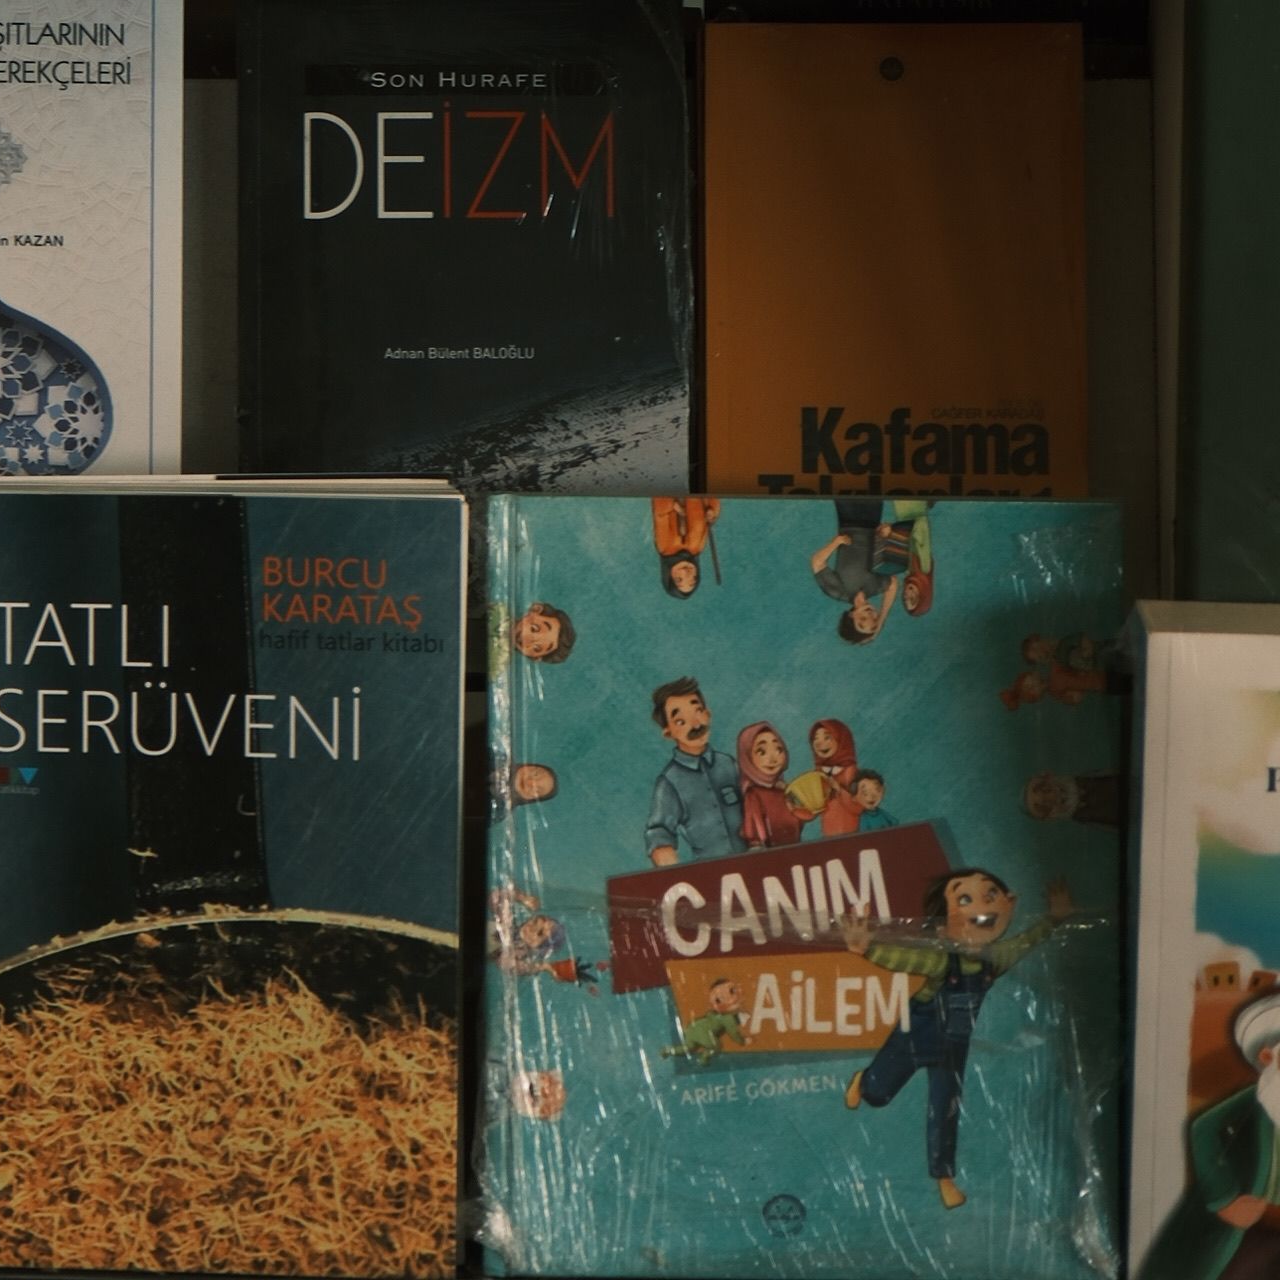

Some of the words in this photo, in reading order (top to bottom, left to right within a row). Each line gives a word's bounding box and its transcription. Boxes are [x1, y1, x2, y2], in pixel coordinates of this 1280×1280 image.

[303, 100, 615, 219] DEİZM
[14, 235, 64, 246] KAZAN
[384, 347, 425, 359] Adnan
[428, 347, 470, 359] Bülent
[472, 344, 535, 359] BALOĞLU
[801, 406, 1050, 474] Kafama
[263, 556, 387, 590] BURCU
[262, 592, 422, 632] KARATAŞ
[259, 629, 309, 650] hafif
[316, 631, 375, 651] tatlar
[383, 632, 444, 653] kitabı
[661, 848, 891, 957] CANIM
[680, 1083, 739, 1105] ARİFE
[745, 1074, 837, 1098] GÖKMEN
